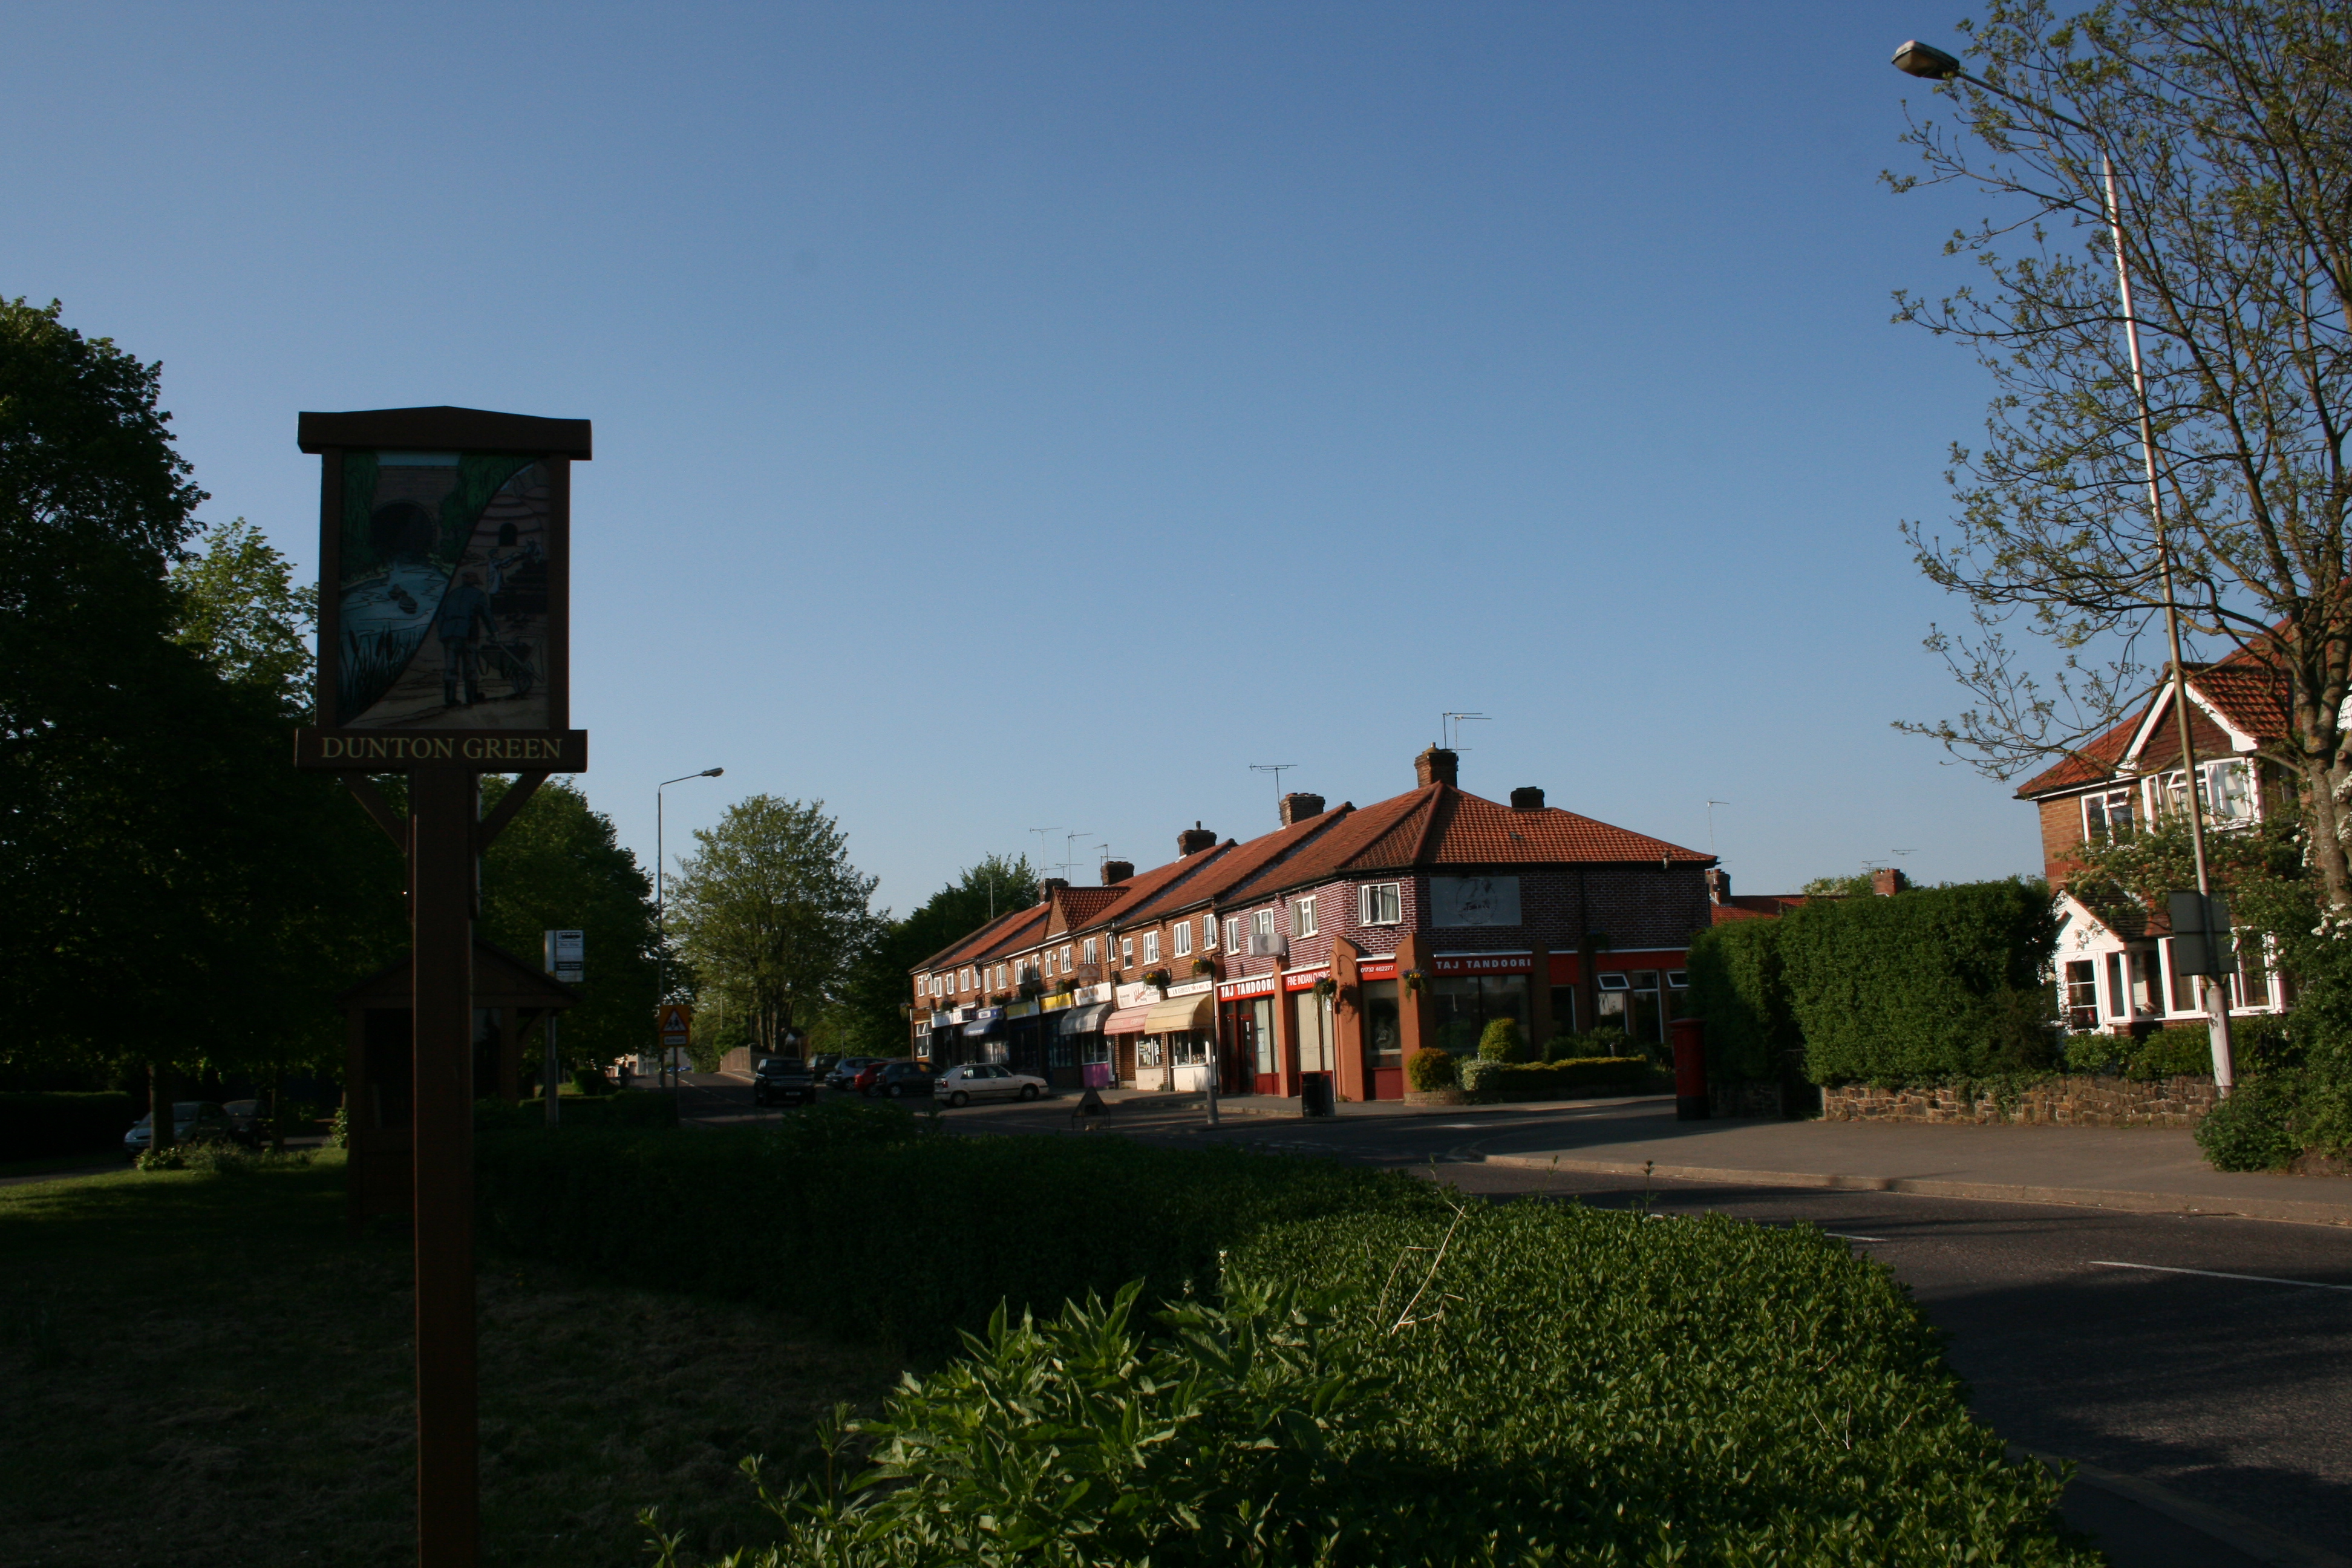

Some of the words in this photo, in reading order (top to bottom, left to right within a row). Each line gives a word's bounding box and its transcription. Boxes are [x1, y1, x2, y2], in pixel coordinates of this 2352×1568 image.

[321, 737, 454, 759] DUNTON
[462, 737, 563, 759] GREEN
[1436, 960, 1459, 969] TAJ
[1466, 958, 1531, 968] TANDOORI
[1287, 975, 1297, 986] FINE
[1298, 973, 1313, 985] INDIAN
[1221, 985, 1234, 998] TAJ
[1236, 978, 1275, 996] TANDOORI
